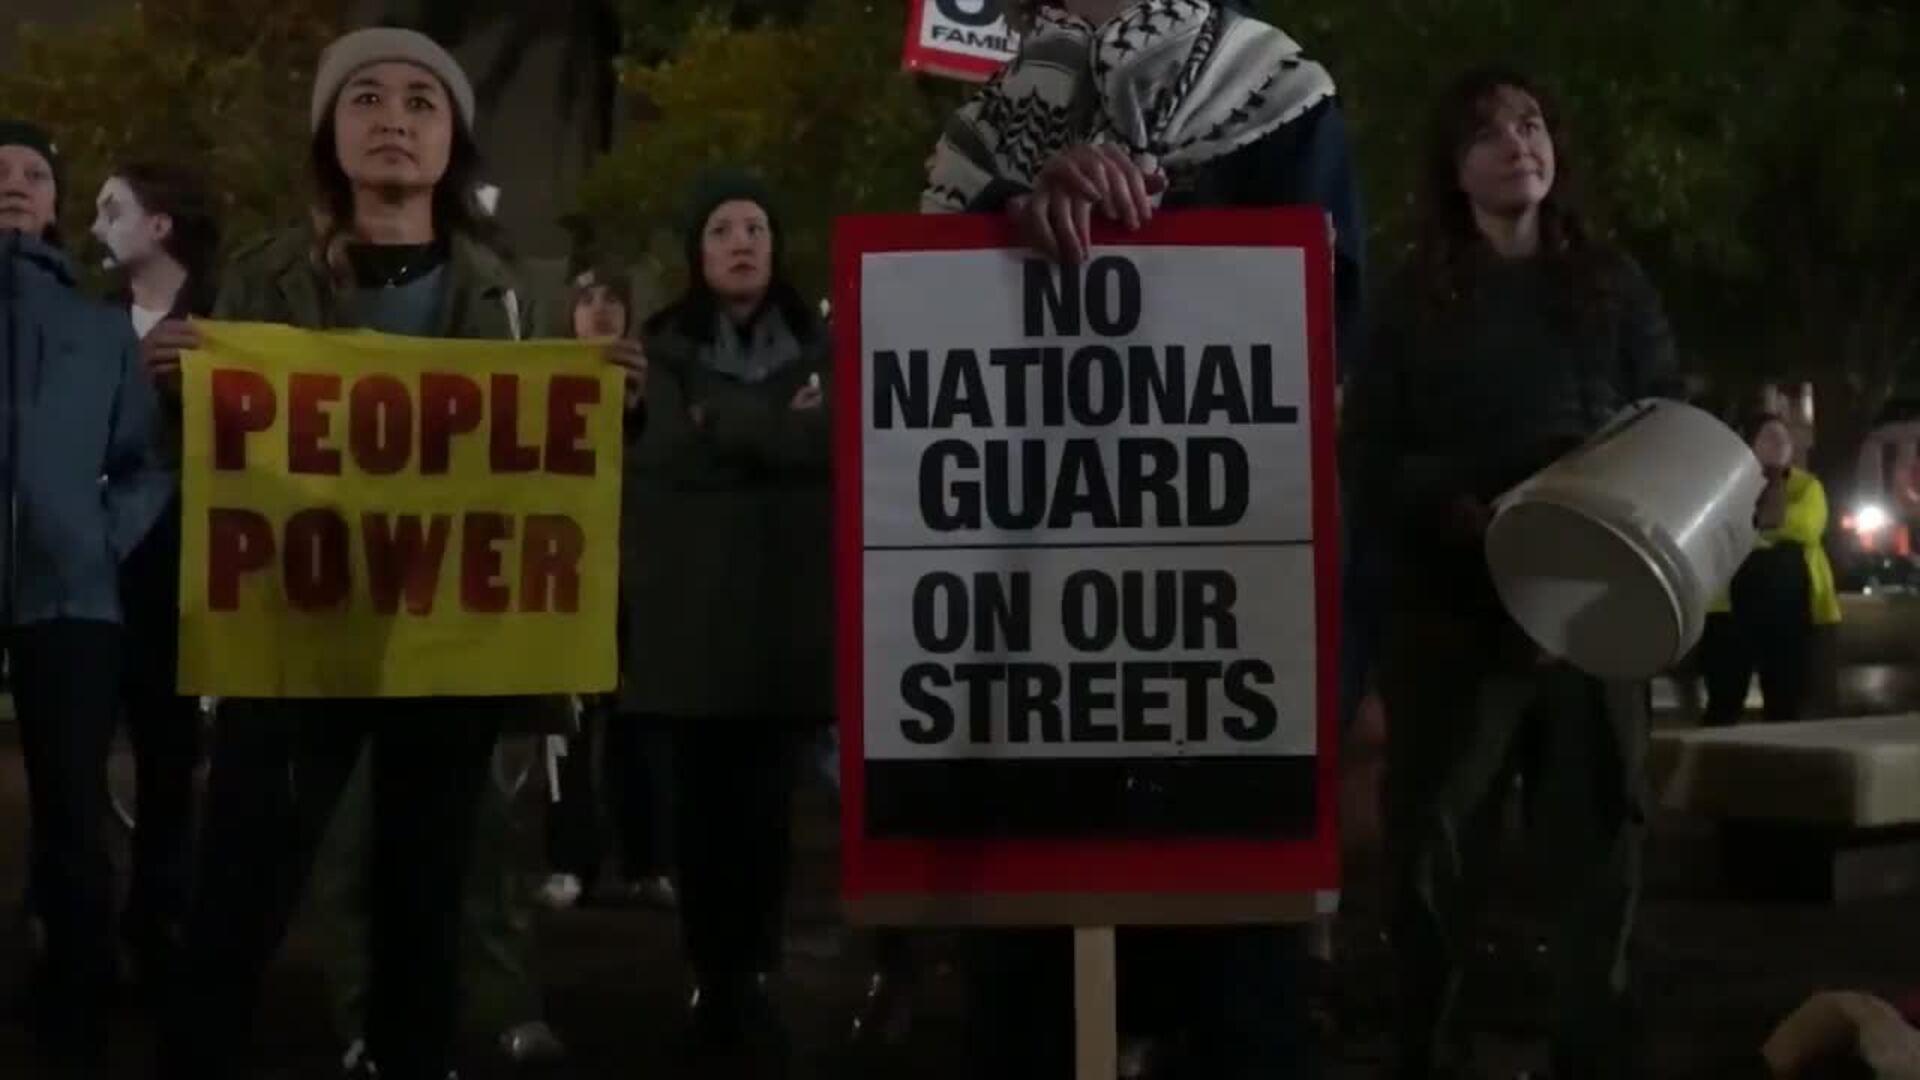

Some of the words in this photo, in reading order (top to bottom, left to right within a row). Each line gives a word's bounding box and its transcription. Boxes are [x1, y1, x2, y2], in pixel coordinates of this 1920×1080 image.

[1023, 255, 1142, 337] NO
[211, 369, 601, 478] PEOPLE
[872, 344, 1299, 430] NATIONAL
[918, 437, 1250, 533] GUARD
[207, 507, 584, 616] POWER
[912, 570, 1033, 655] ON
[1061, 569, 1239, 653] OUR
[899, 658, 1279, 745] STREETS
